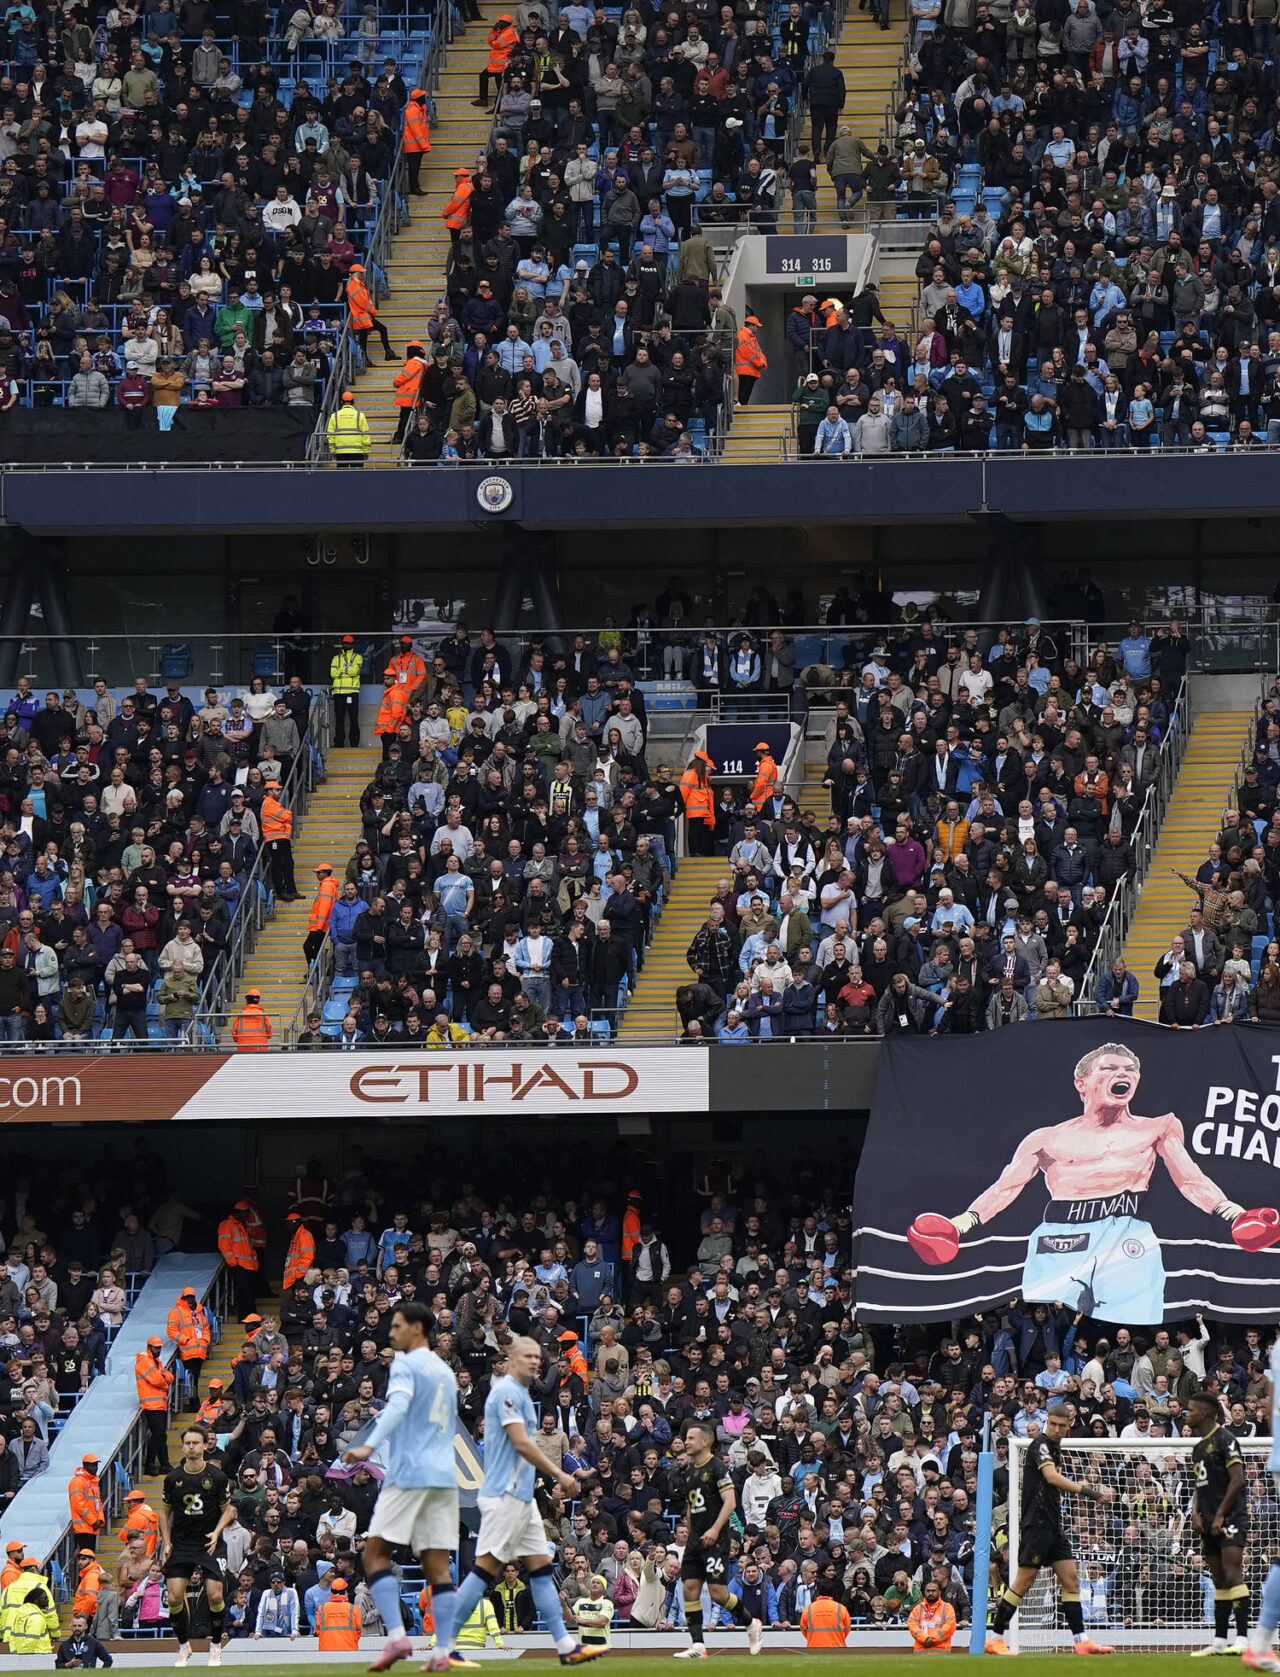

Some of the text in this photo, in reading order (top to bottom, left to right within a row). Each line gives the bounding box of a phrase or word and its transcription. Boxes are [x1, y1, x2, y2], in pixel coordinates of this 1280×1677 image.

[781, 258, 832, 272] 314 315
[722, 759, 744, 774] 114
[349, 1062, 640, 1104] ETIHAD
[1066, 1193, 1138, 1221] HITMAN
[428, 1381, 449, 1433] 4
[183, 1493, 204, 1511] 96
[689, 1488, 705, 1509] 96
[706, 1557, 725, 1573] 24
